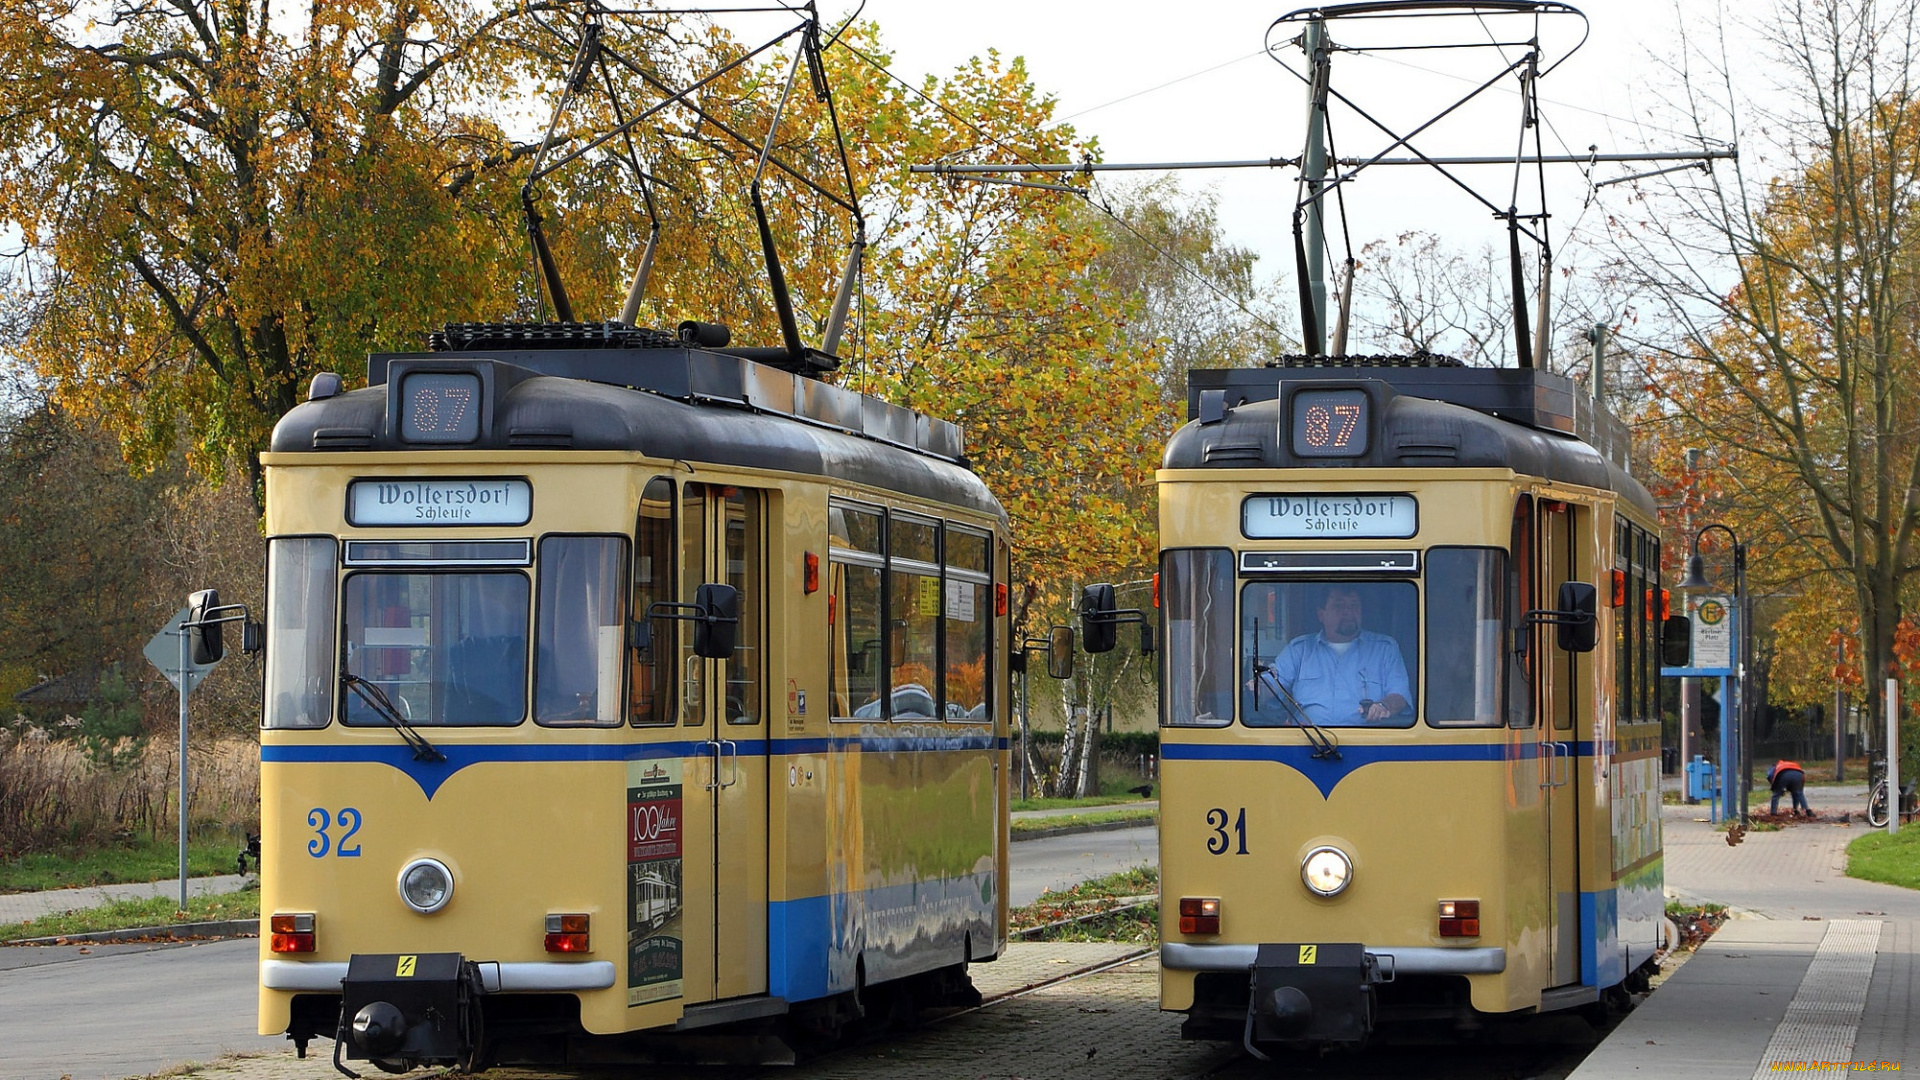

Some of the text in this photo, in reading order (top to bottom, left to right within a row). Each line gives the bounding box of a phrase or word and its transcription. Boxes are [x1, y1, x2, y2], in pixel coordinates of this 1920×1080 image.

[414, 388, 471, 432] 87
[1306, 405, 1360, 447] 87
[377, 483, 510, 506] Woltersdorf
[1268, 497, 1395, 518] Woltersdorf
[307, 807, 363, 858] 32
[633, 805, 660, 842] 100
[1206, 807, 1250, 855] 31
